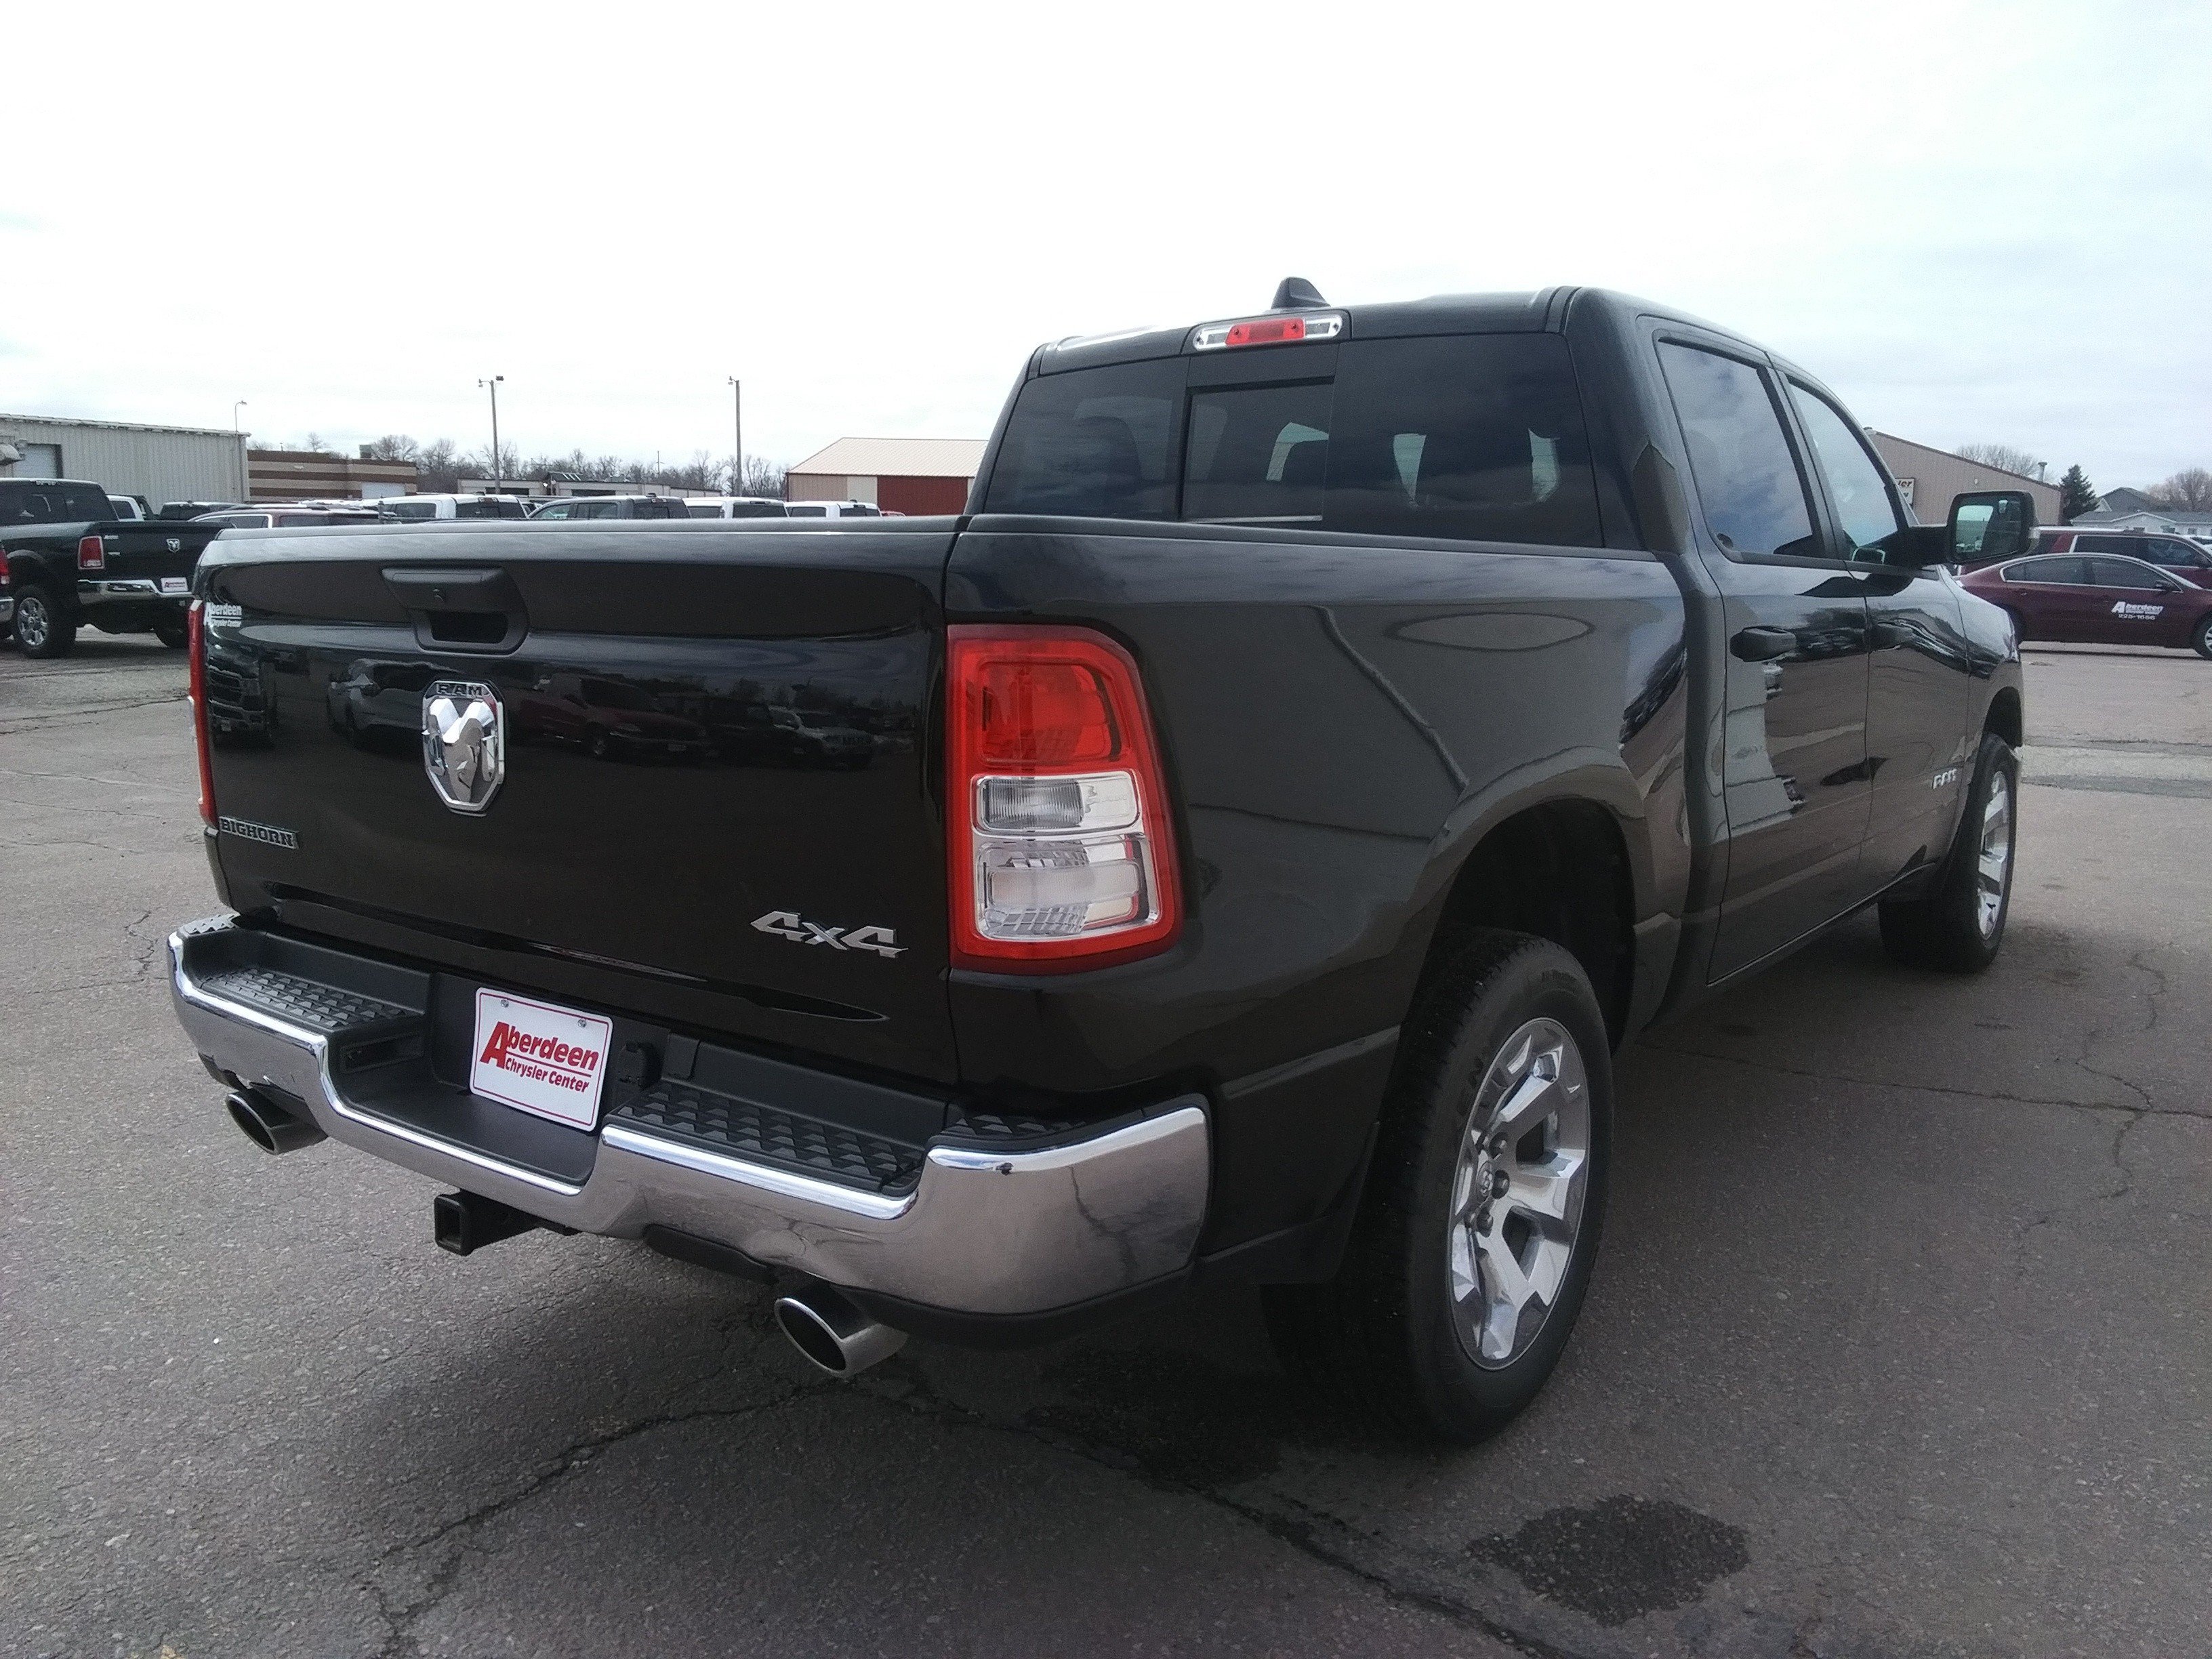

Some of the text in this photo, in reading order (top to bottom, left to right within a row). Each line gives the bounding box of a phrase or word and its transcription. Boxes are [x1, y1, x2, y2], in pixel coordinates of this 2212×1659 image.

[203, 601, 242, 626] Aberdeen
[436, 683, 484, 698] RAM
[220, 817, 294, 848] BIGHORN
[480, 1021, 599, 1071] Aberdeen
[505, 1057, 590, 1093] Chrysler Center
